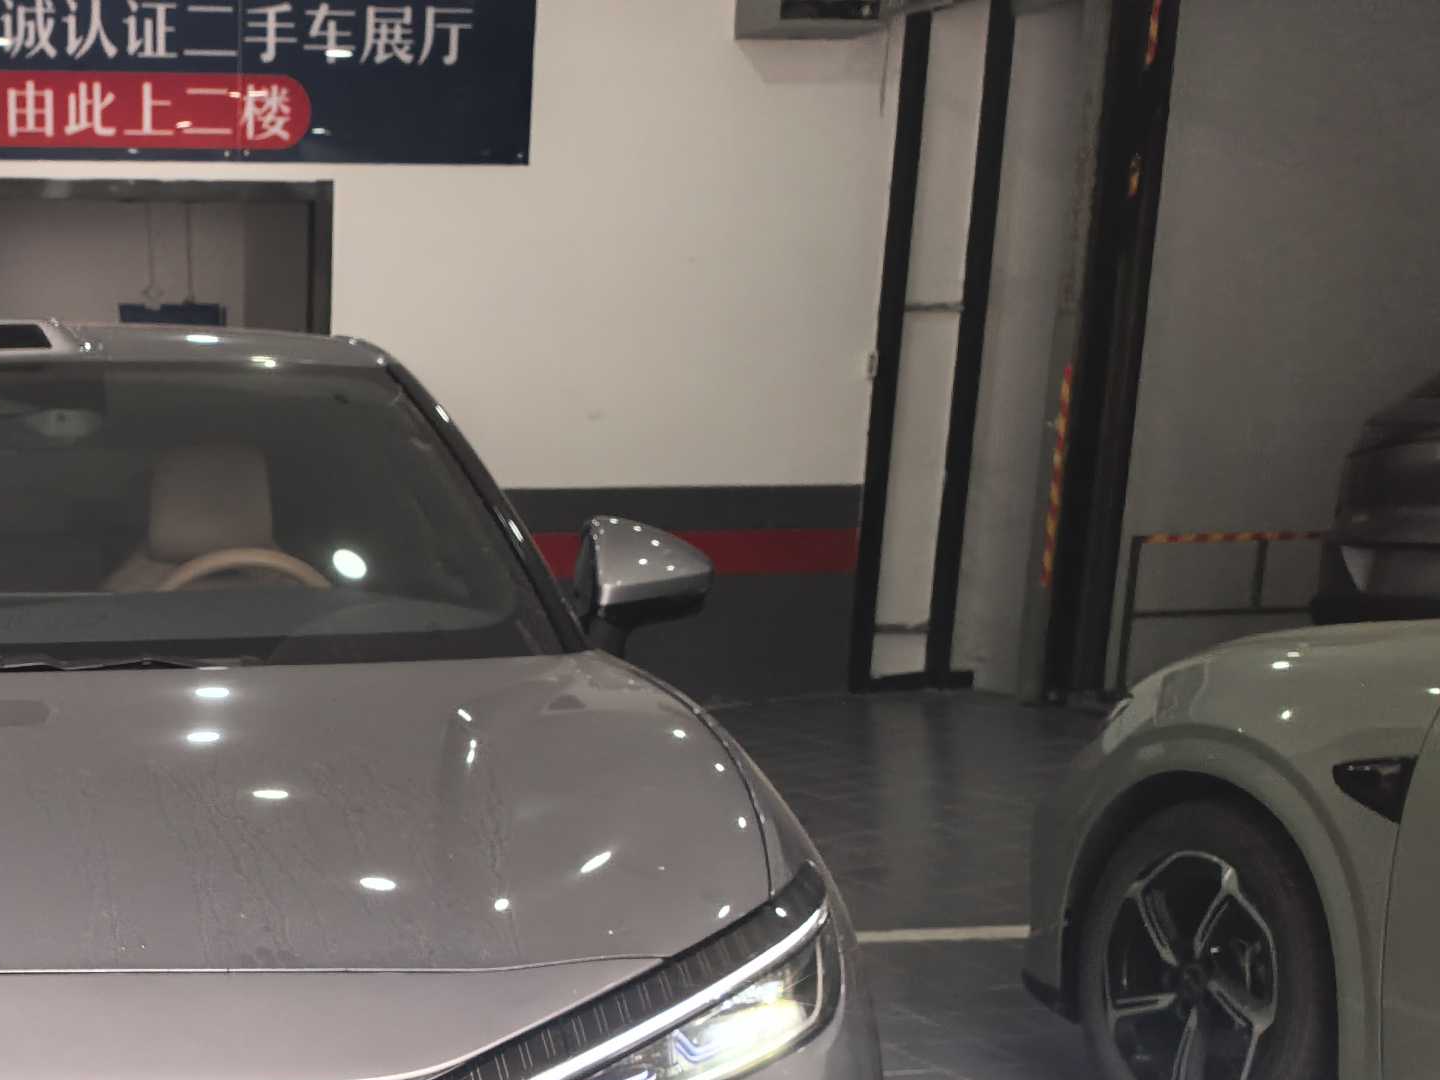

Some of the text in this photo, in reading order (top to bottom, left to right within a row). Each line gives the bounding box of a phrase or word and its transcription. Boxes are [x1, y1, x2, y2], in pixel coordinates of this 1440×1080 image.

[7, 79, 292, 142] 由此上二楼
